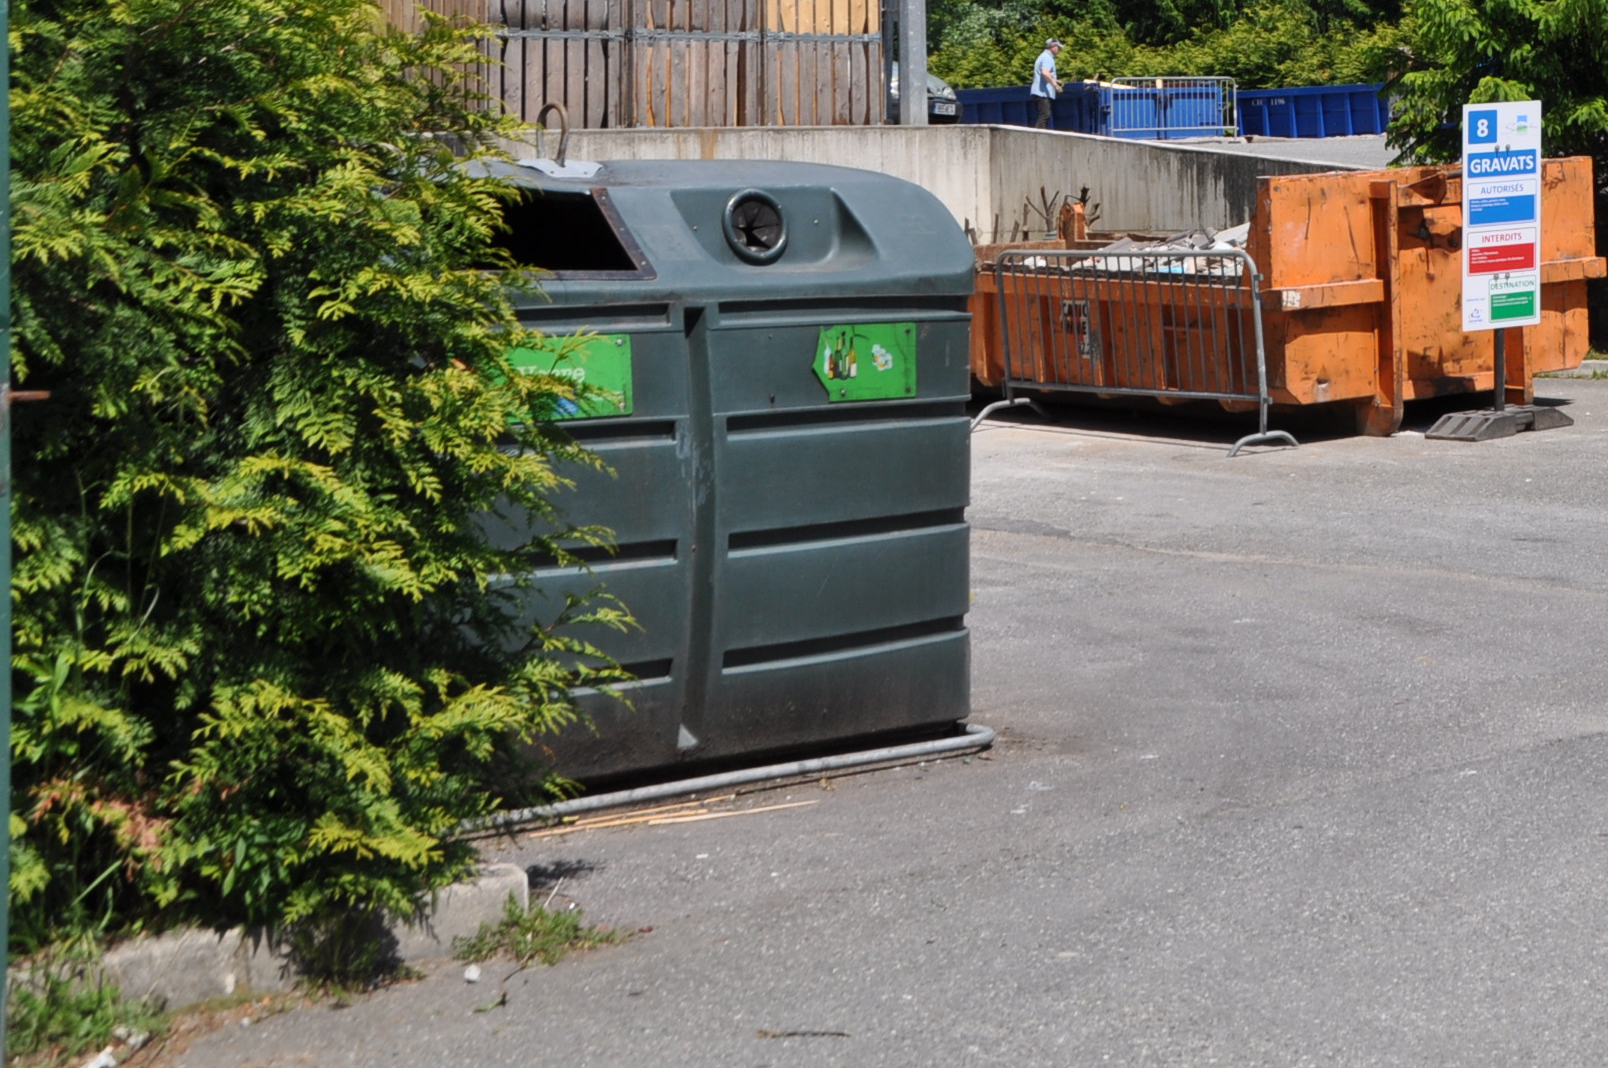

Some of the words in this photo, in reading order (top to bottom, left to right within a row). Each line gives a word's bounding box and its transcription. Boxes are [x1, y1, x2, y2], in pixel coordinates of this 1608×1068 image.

[1477, 119, 1489, 138] 8
[1470, 155, 1535, 175] GRAVATS
[1480, 183, 1524, 196] AUTORISÉS
[1481, 232, 1522, 244] INTERDITS
[1490, 279, 1535, 291] DESTINATION
